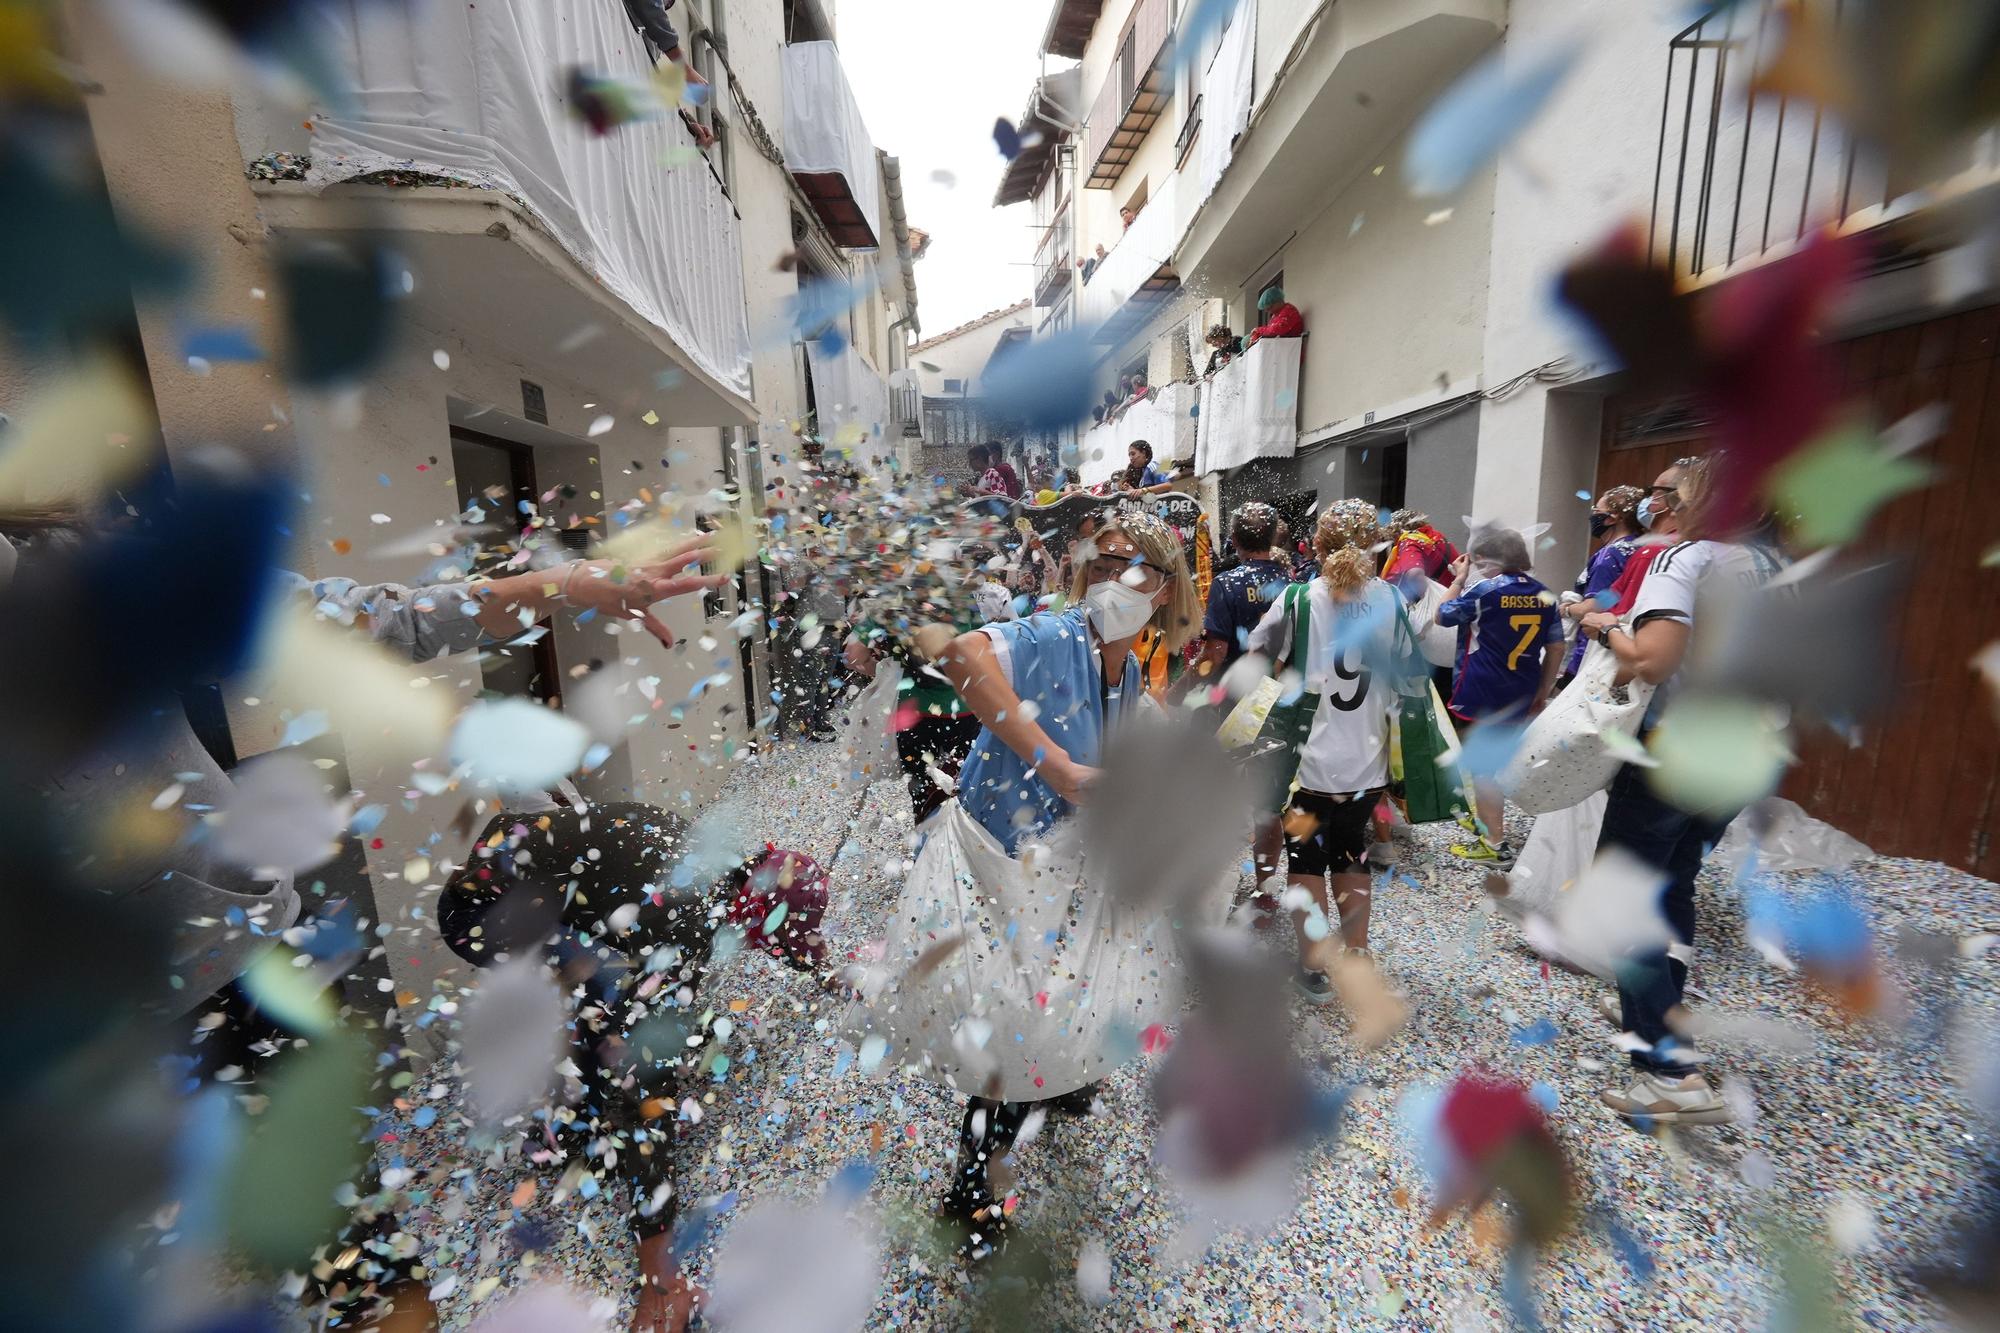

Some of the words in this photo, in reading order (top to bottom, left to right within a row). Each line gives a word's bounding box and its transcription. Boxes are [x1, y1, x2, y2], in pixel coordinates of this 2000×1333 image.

[1170, 499, 1193, 512] DEL
[1501, 595, 1549, 608] BASSET
[1507, 615, 1541, 671] 7
[1330, 640, 1371, 711] 9
